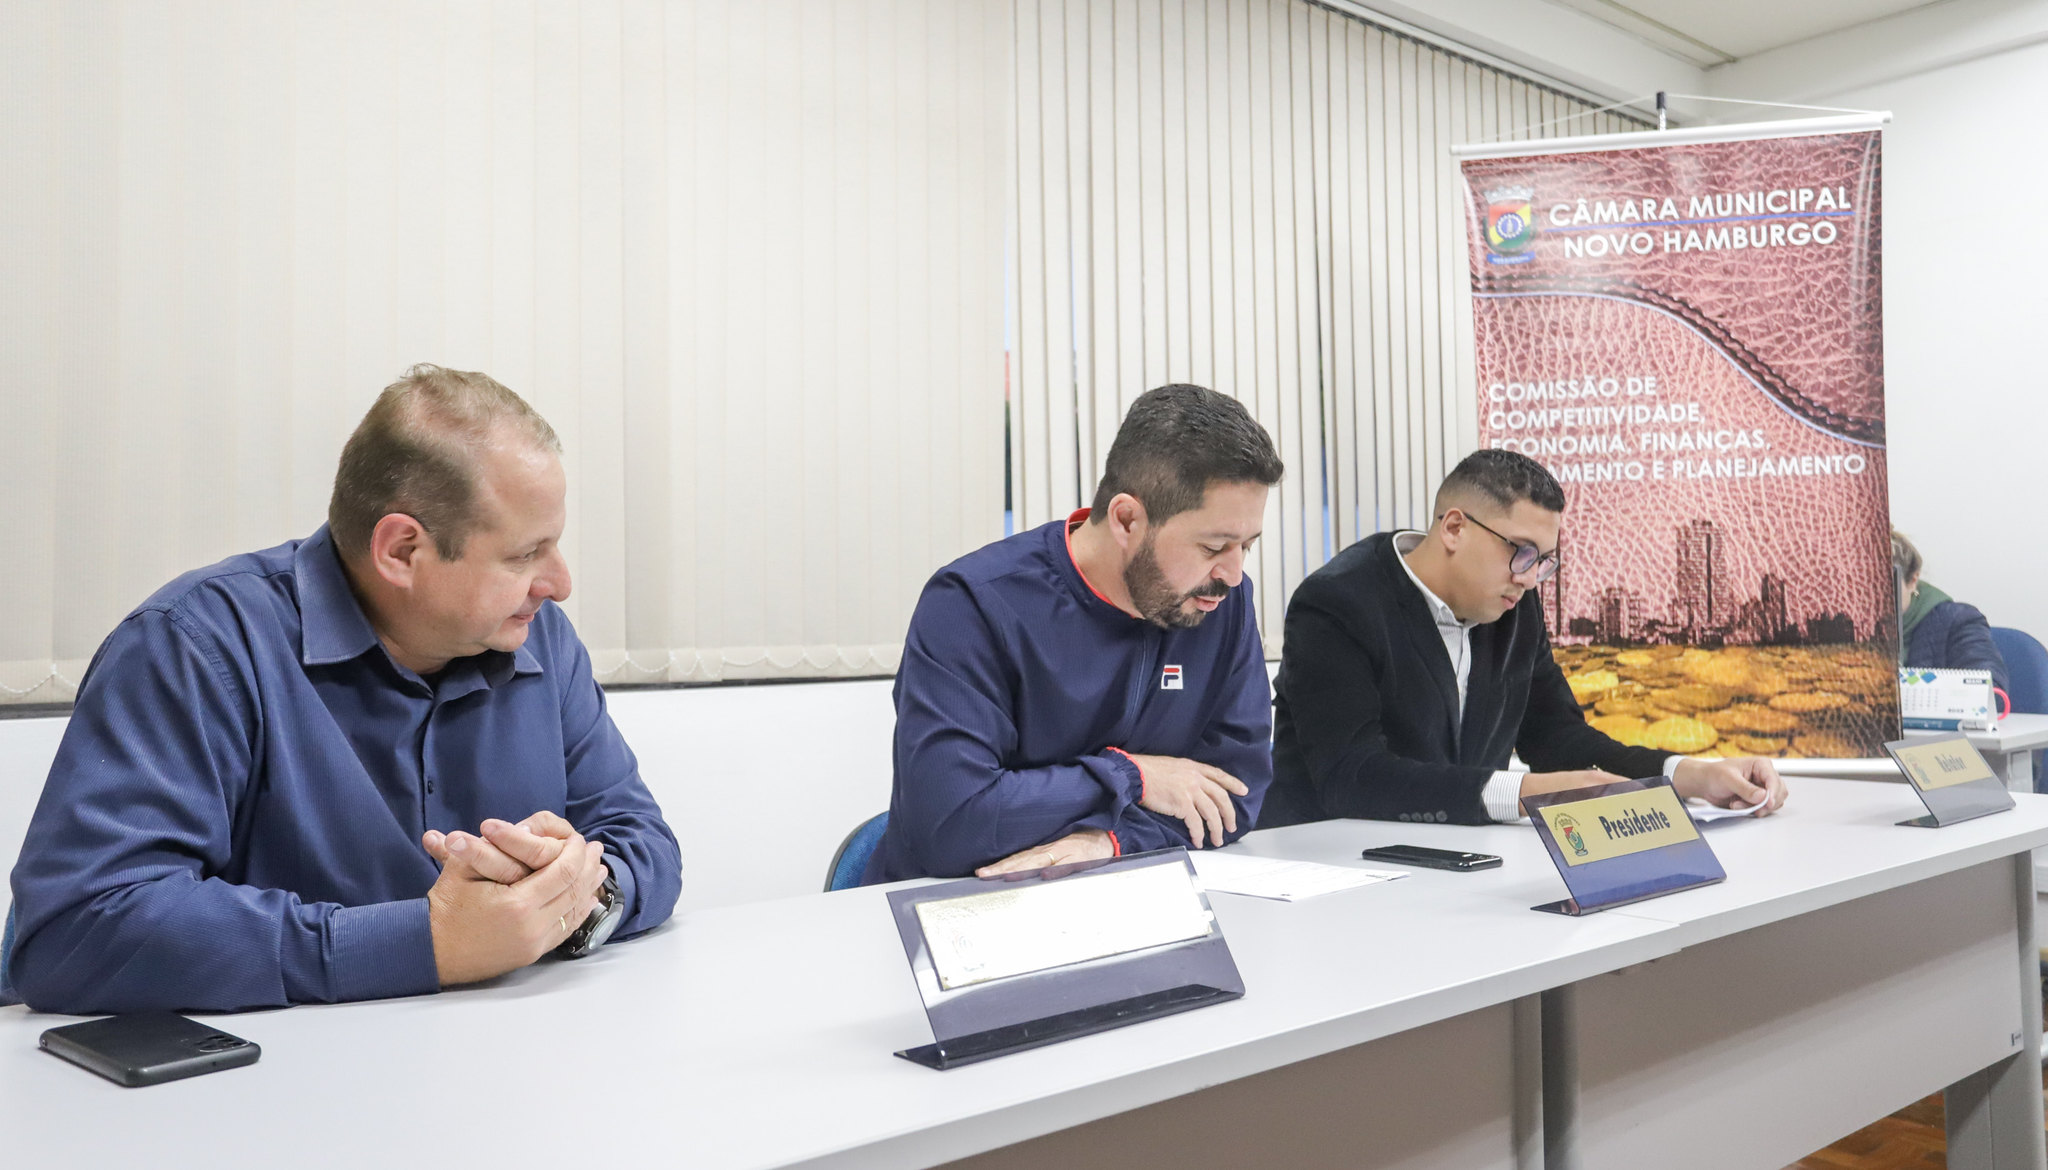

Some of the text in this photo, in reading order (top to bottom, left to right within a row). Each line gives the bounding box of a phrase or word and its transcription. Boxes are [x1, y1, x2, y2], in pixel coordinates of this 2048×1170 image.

[1549, 186, 1852, 227] CÂMARA MUNICIPAL
[1563, 220, 1838, 259] NOVO HAMBURGO
[1488, 375, 1657, 403] COMISSÃO DE
[1489, 402, 1706, 430] COMPETITIVIDADE,
[1641, 428, 1772, 454] FINANÇAS,
[1652, 460, 1666, 480] E
[1672, 454, 1866, 479] PLANEJAMENTO
[1598, 807, 1671, 840] Presidente
